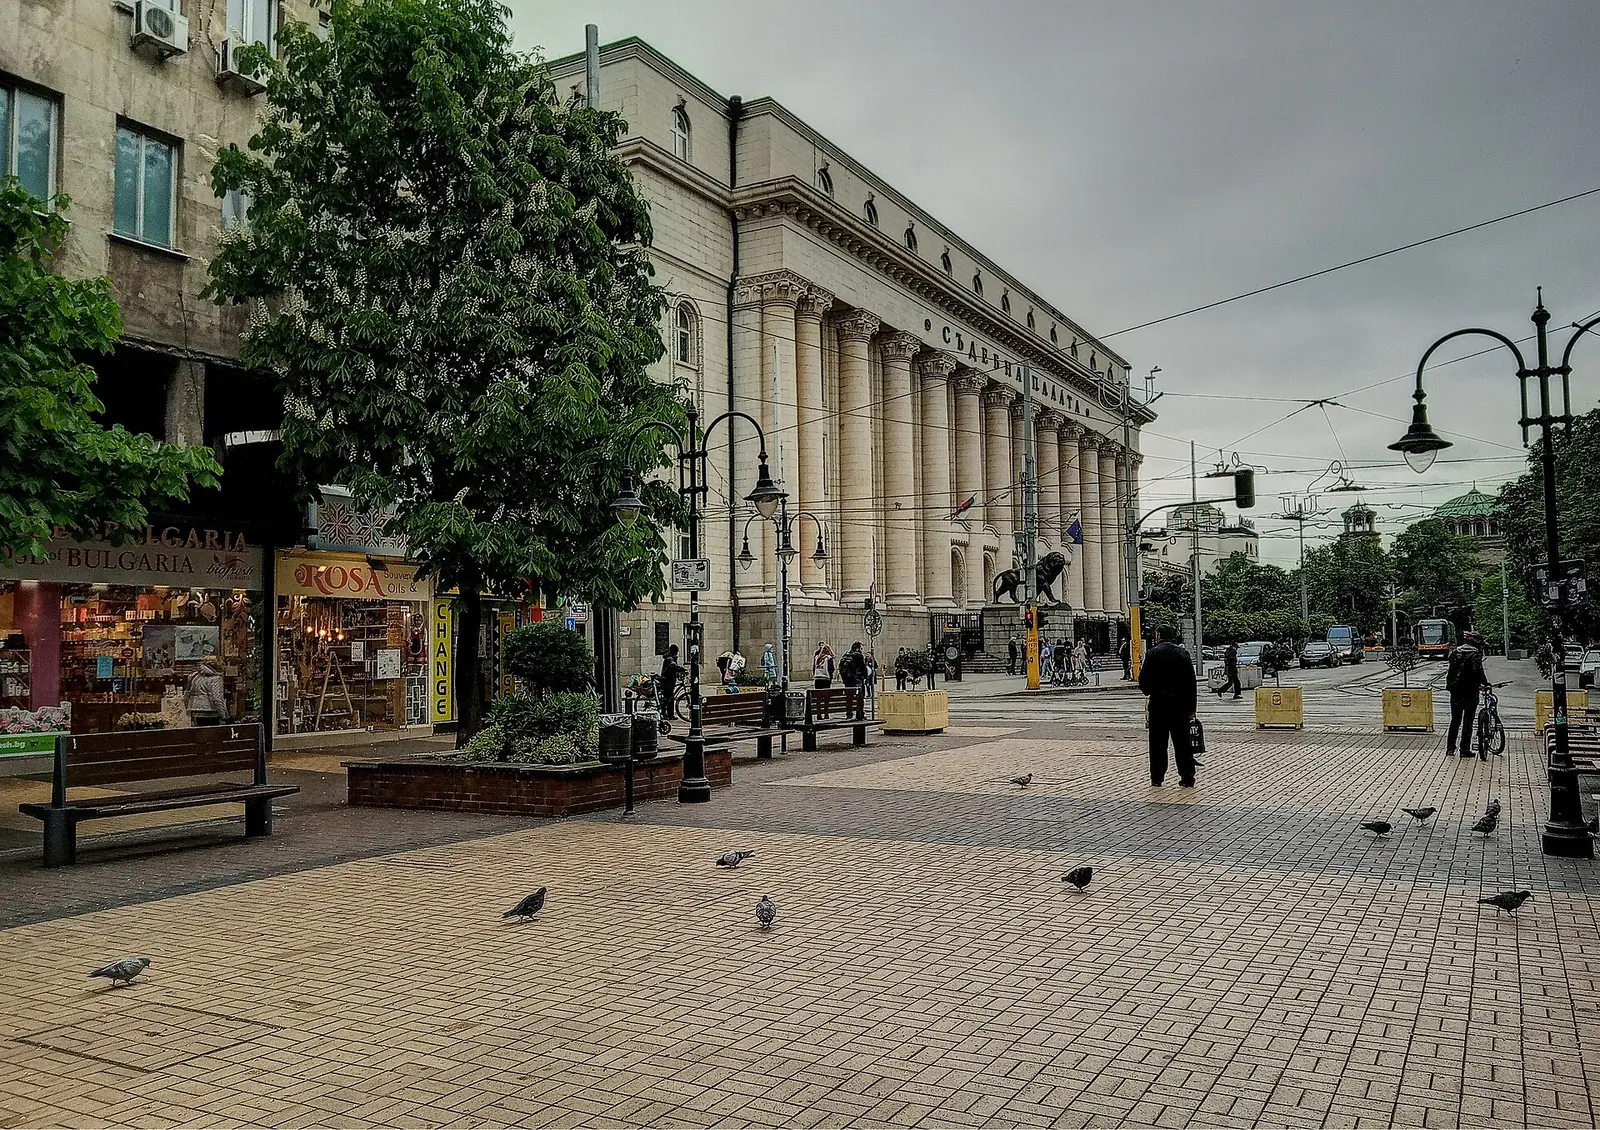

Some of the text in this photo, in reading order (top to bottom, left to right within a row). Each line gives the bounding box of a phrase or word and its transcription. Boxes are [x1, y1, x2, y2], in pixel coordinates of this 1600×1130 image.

[1031, 375, 1080, 413] ПАЛАТА
[104, 520, 249, 553] BLGARIA
[66, 547, 195, 574] BULGARIA
[294, 562, 387, 596] ROSA
[387, 582, 417, 593] Oils &
[436, 603, 447, 715] CHANGE
